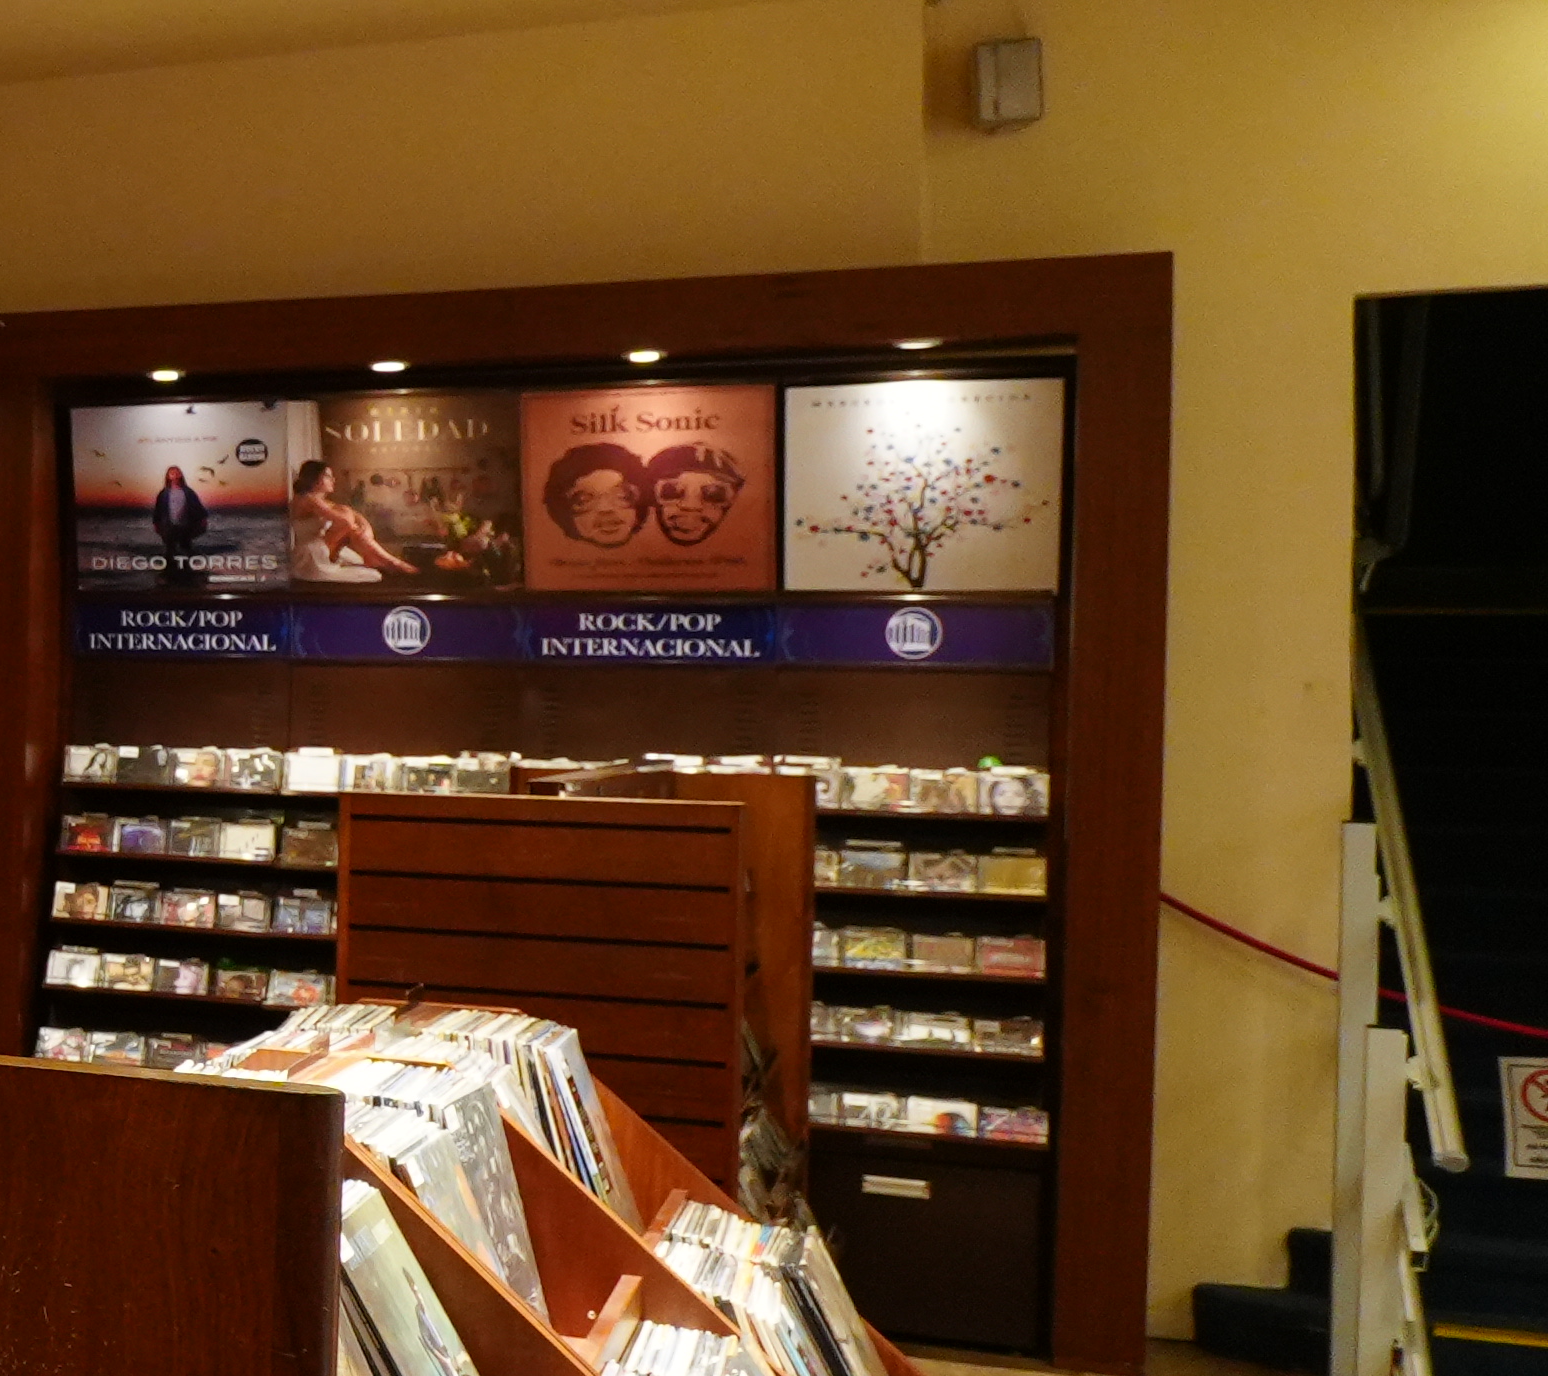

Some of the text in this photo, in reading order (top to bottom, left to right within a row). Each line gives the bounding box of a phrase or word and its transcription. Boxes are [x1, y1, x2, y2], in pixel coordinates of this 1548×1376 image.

[570, 405, 721, 434] Silk Sonic
[92, 554, 277, 570] DIEGO TORRES
[120, 610, 243, 628] ROCK/POP
[578, 612, 722, 632] ROCK/POP
[88, 632, 276, 652] INTERNACIONAL
[541, 637, 760, 658] INTERNACIONAL
